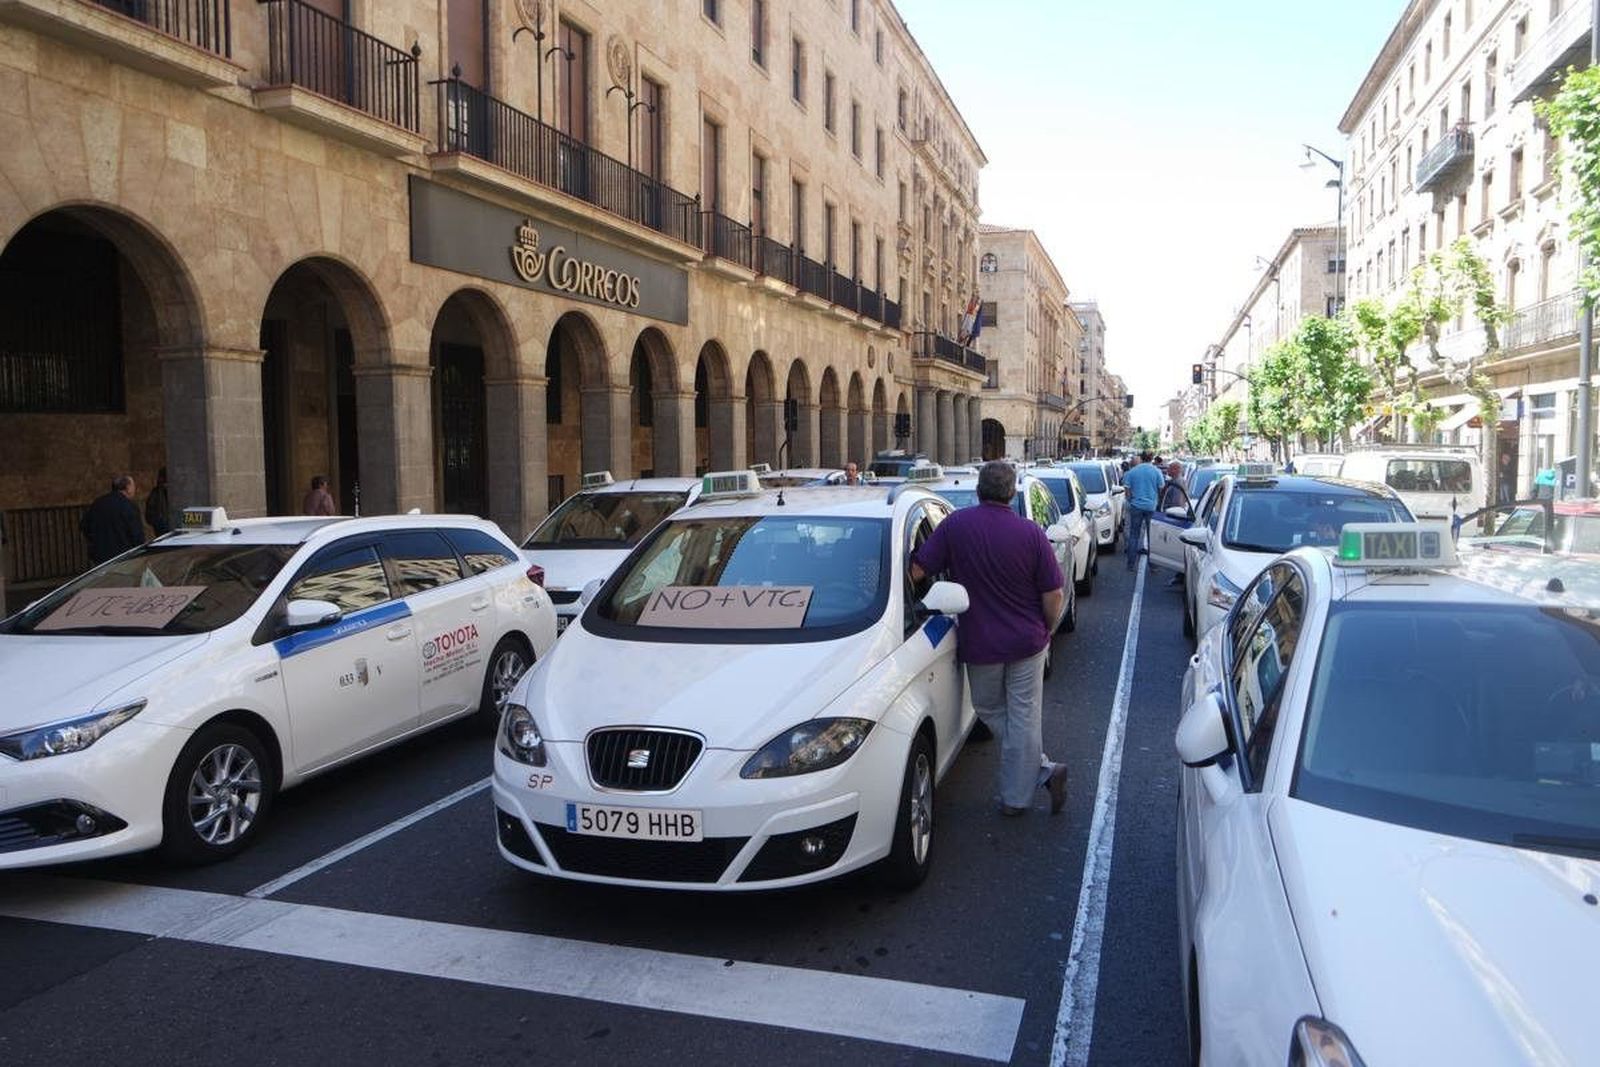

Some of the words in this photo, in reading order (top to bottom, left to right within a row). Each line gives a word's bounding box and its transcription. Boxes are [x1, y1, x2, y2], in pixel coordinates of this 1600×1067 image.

[549, 246, 641, 308] CORREOS
[184, 511, 203, 524] TAXI
[1365, 533, 1416, 558] TAXI
[434, 623, 479, 653] TOYOTA
[527, 774, 553, 790] SP
[581, 807, 640, 834] 5079
[649, 812, 696, 838] HHB
